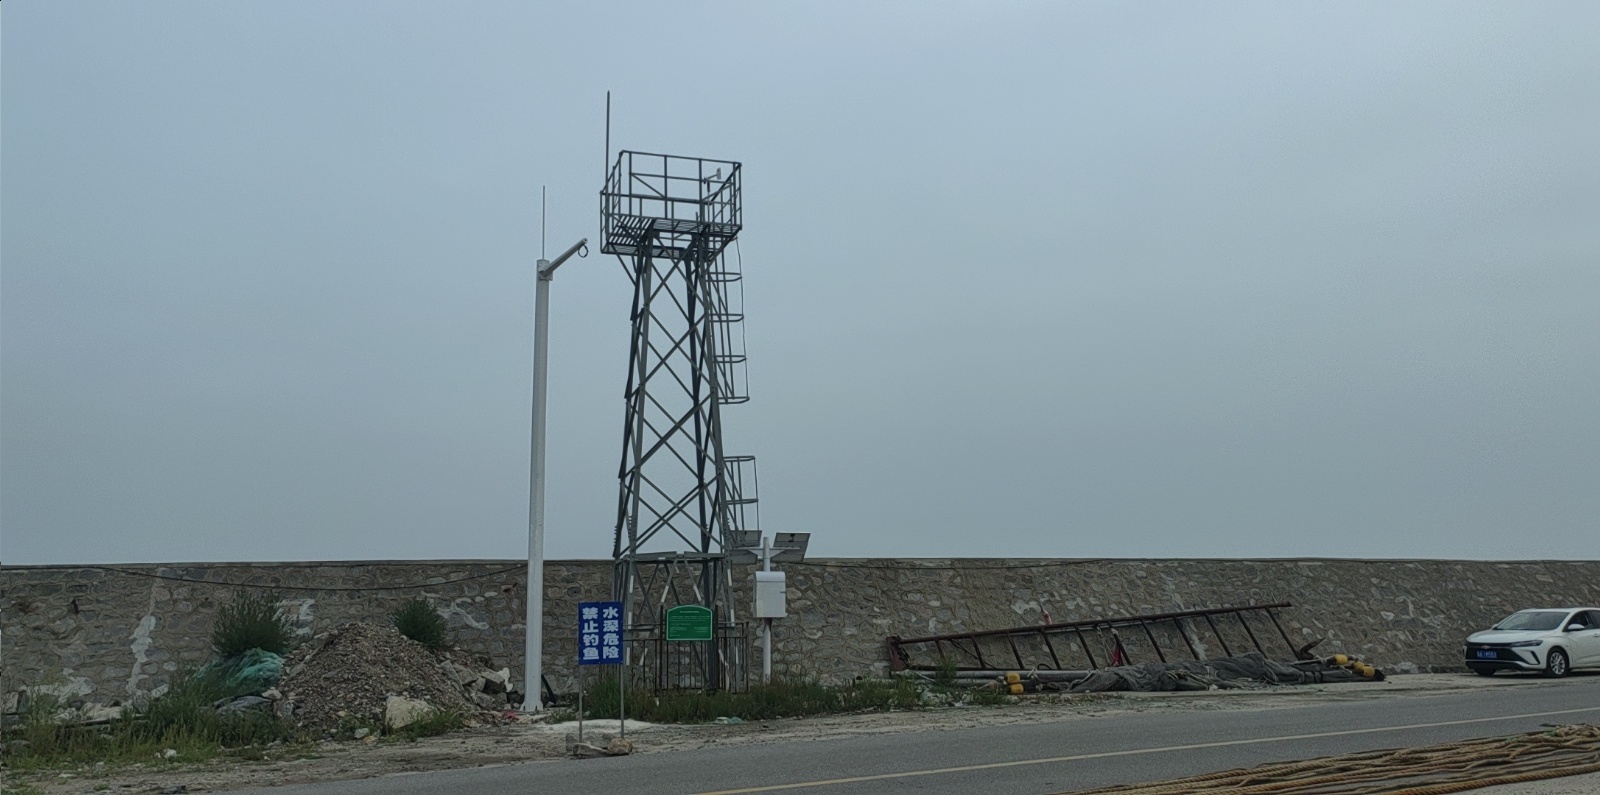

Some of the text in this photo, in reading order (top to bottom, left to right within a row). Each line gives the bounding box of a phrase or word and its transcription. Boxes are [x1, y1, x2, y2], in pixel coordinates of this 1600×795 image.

[582, 607, 599, 660] 禁止钓鱼
[603, 606, 619, 659] 水深危险
